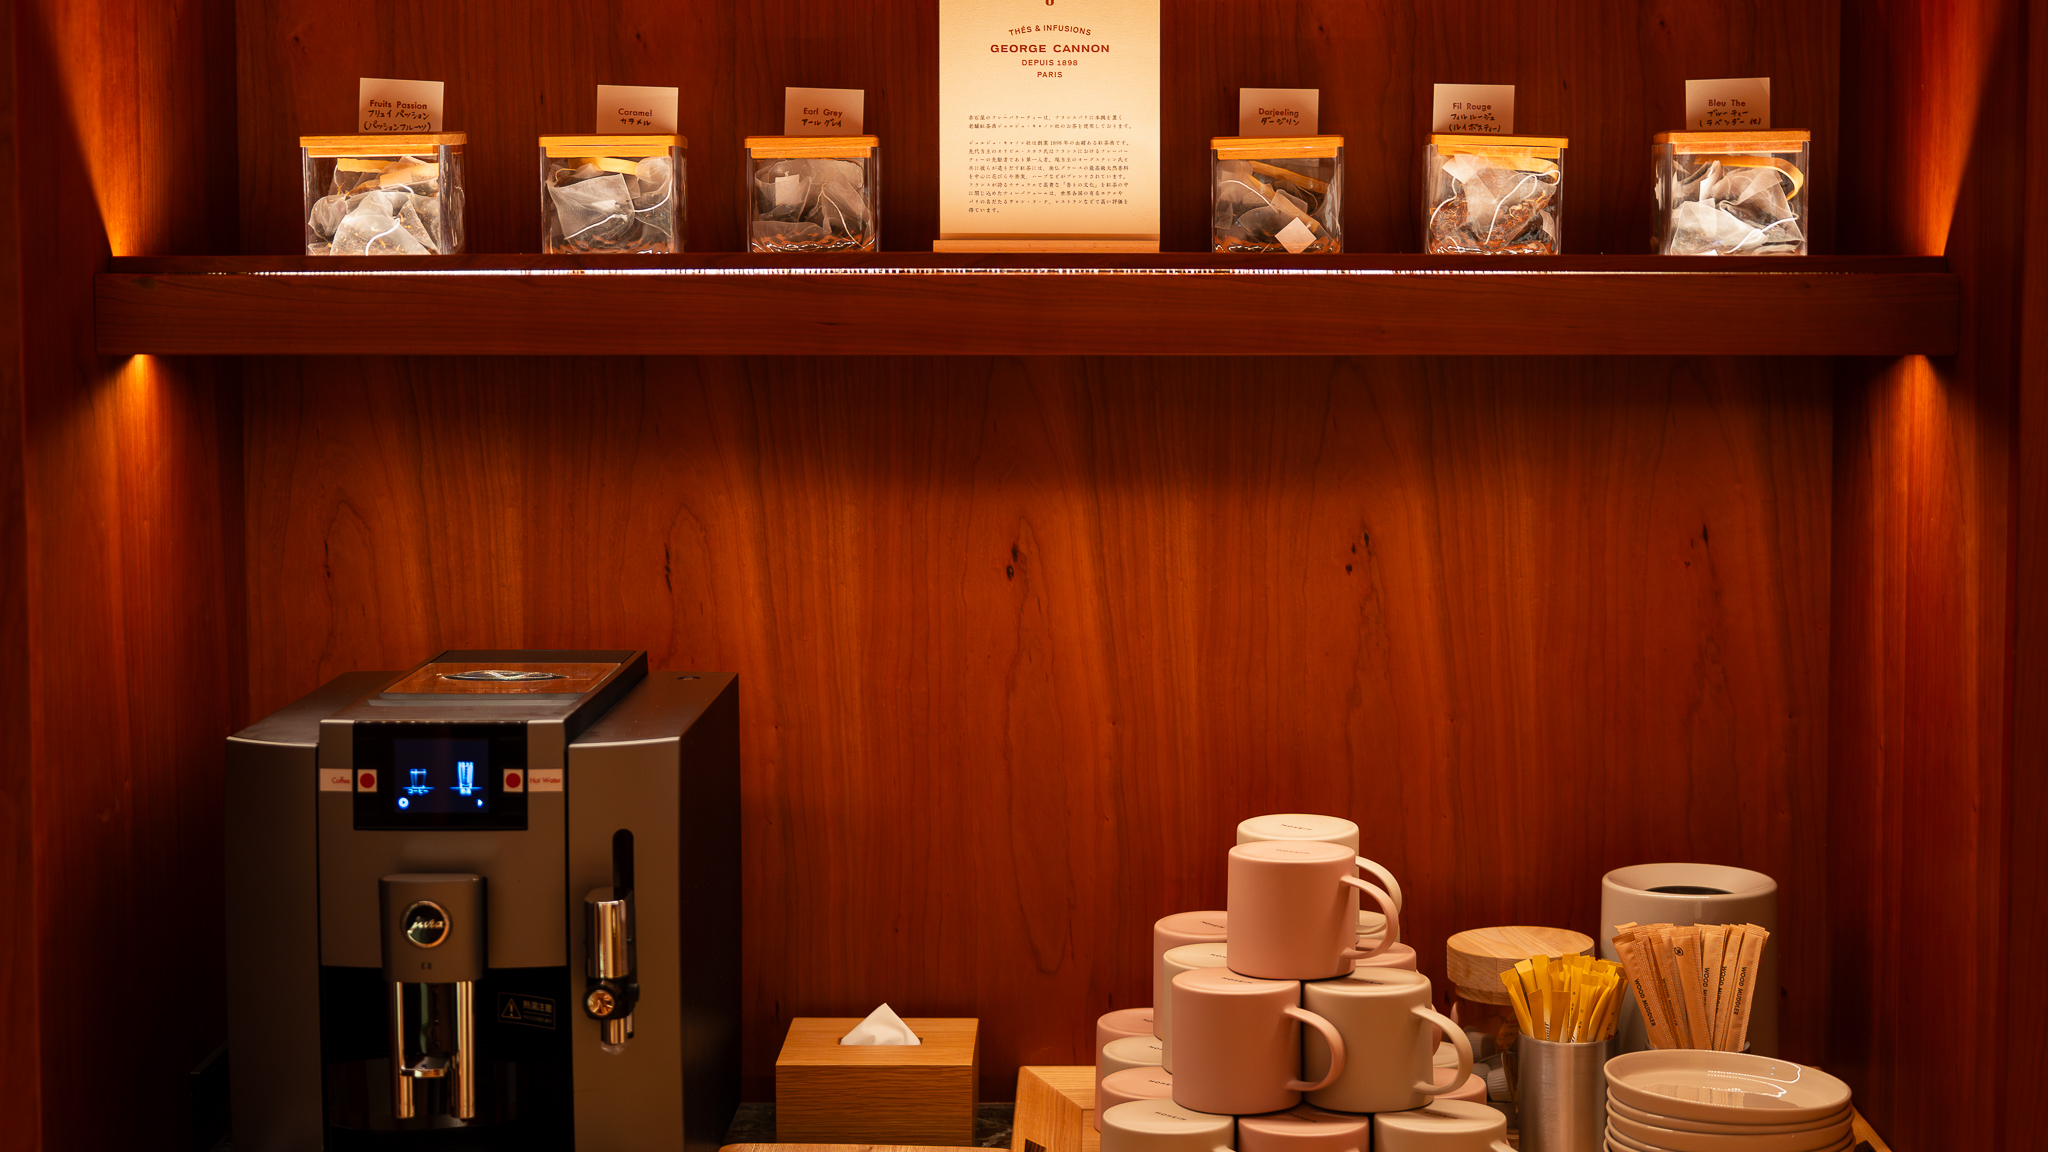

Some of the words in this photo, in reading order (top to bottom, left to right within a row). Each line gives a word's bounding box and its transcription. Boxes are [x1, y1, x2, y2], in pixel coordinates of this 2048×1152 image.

[1008, 25, 1032, 36] THÉS
[1043, 24, 1092, 36] INFUSIONS
[990, 44, 1047, 53] GEORGE
[1053, 44, 1110, 53] CANNON
[370, 99, 392, 108] Fruits
[396, 101, 428, 110] Passion
[1452, 102, 1462, 110] Fil
[1466, 102, 1492, 111] Rouge
[1708, 99, 1727, 107] Bleu
[1731, 99, 1746, 107] The
[618, 107, 653, 117] Caramel
[803, 107, 819, 115] Earl
[823, 108, 843, 118] Grey
[1258, 107, 1299, 118] Darjeeling
[620, 118, 652, 126] カラメル
[1260, 117, 1300, 126] ダージリン
[1702, 967, 1710, 988] WOOD
[1739, 966, 1747, 987] WOOD
[1634, 978, 1645, 999] WOOD
[1642, 999, 1657, 1027] MUDDLER
[1733, 988, 1744, 1015] MUDDLER
